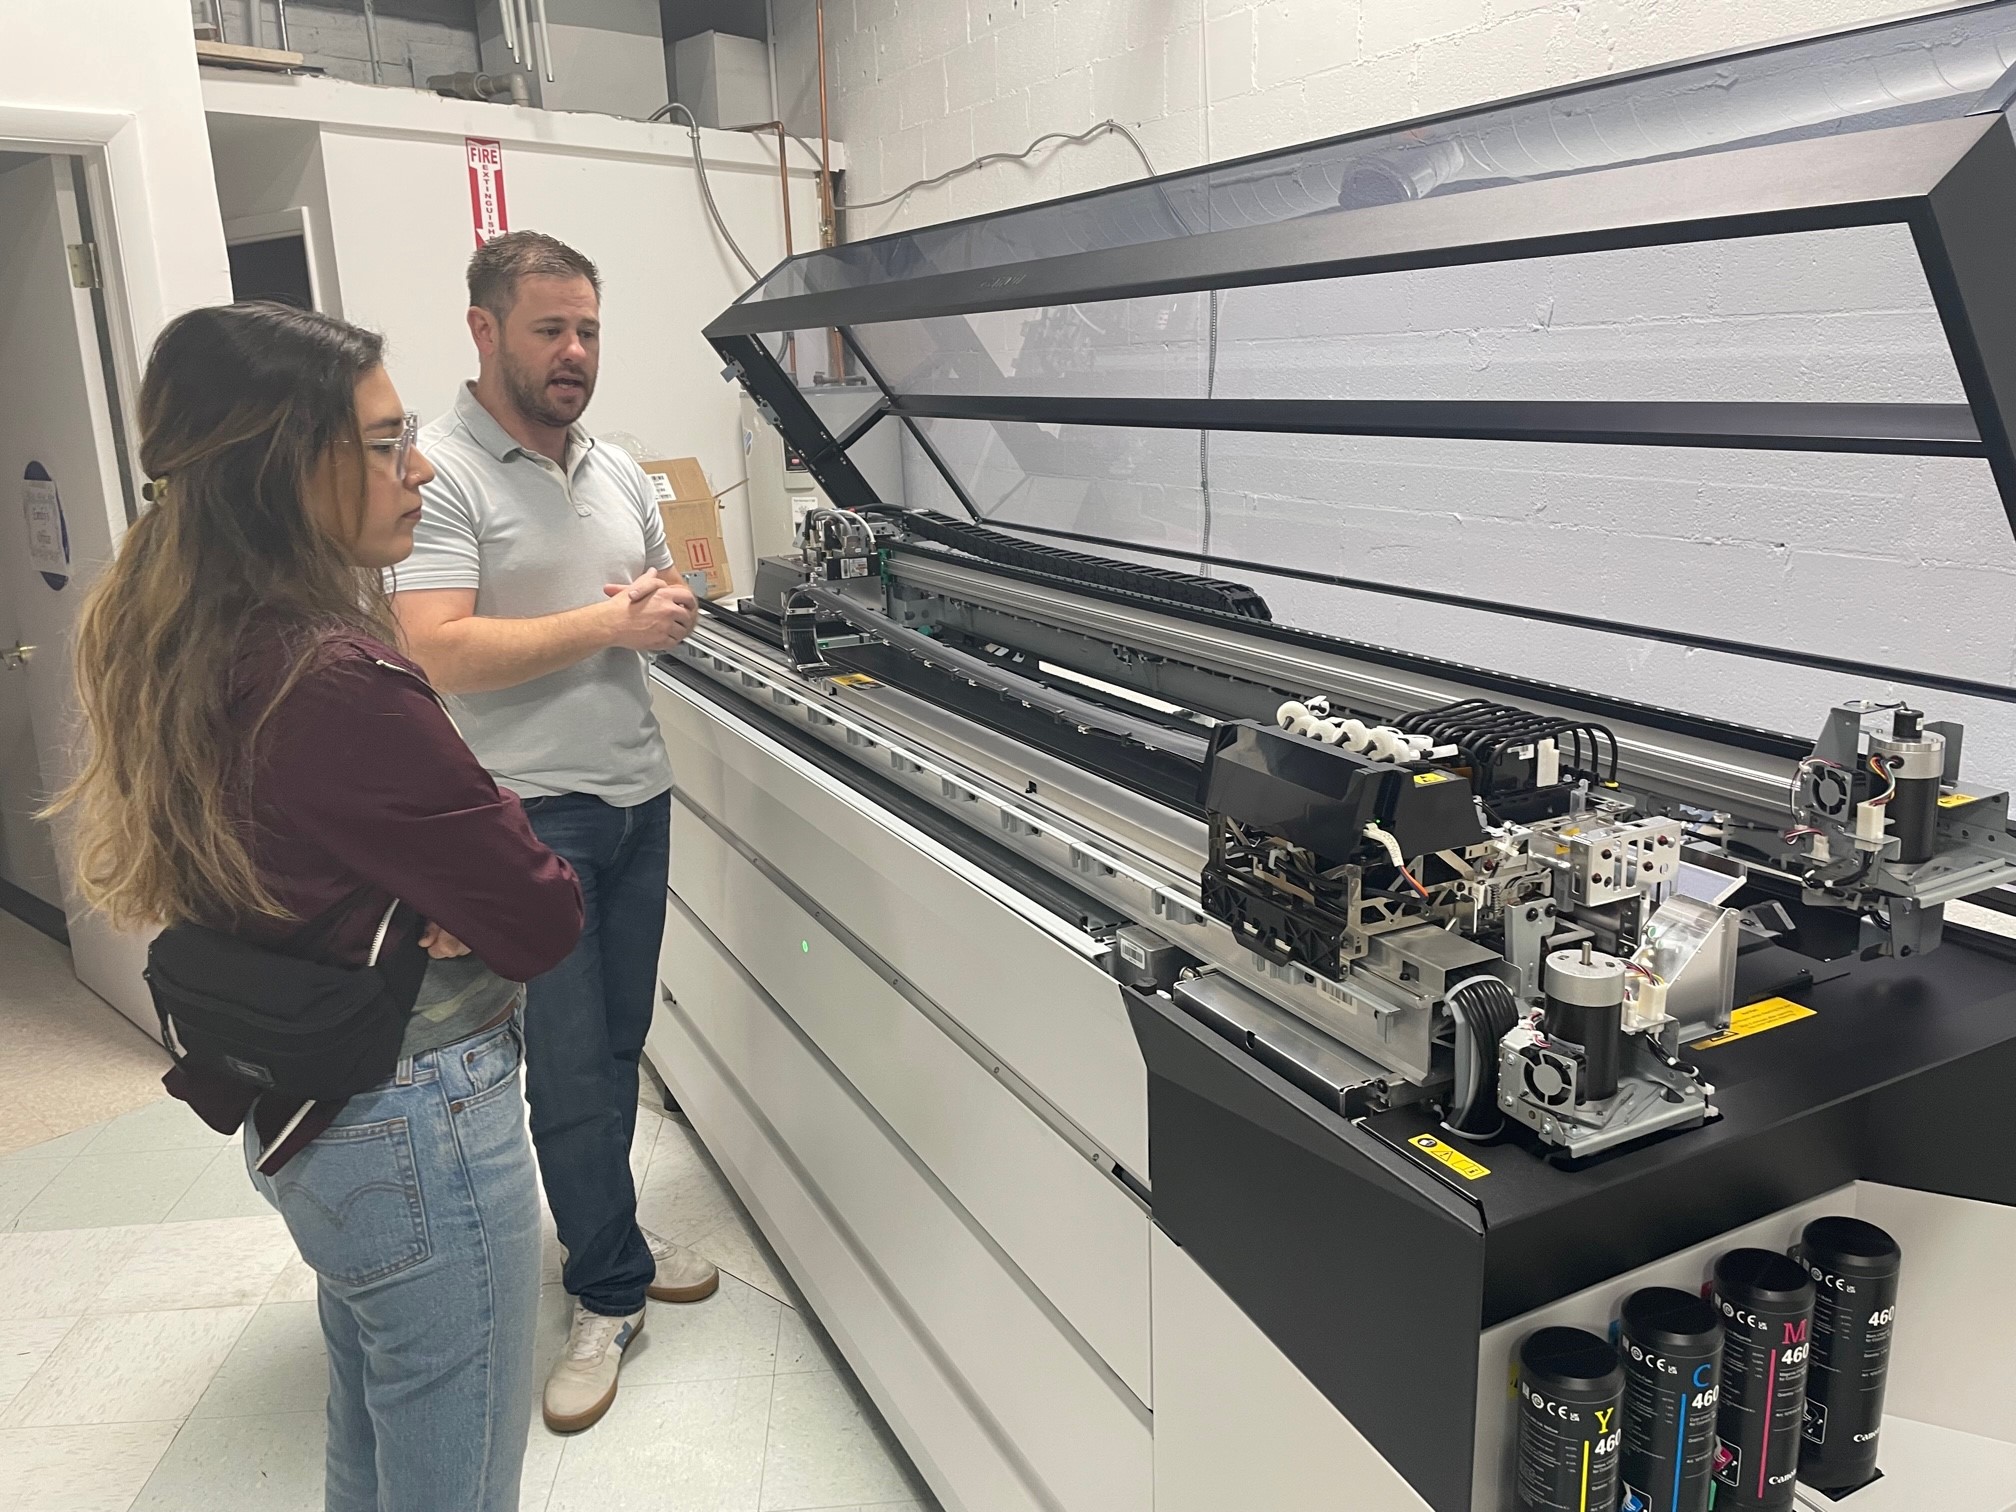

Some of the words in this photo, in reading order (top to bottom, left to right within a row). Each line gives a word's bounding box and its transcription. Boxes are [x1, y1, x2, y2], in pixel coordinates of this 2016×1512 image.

[470, 147, 499, 165] FIRE
[482, 164, 496, 242] EXTINGUISHE
[1825, 1275, 1845, 1291] CE
[1736, 1310, 1757, 1328] CE
[1868, 1305, 1895, 1327] 460
[1781, 1318, 1808, 1345] M
[1645, 1354, 1667, 1372] CE
[1781, 1342, 1810, 1365] 460
[1692, 1363, 1711, 1388] C
[1691, 1384, 1720, 1409] 460
[1546, 1402, 1568, 1420] CE
[1594, 1407, 1615, 1434] Y
[1594, 1428, 1622, 1456] 460
